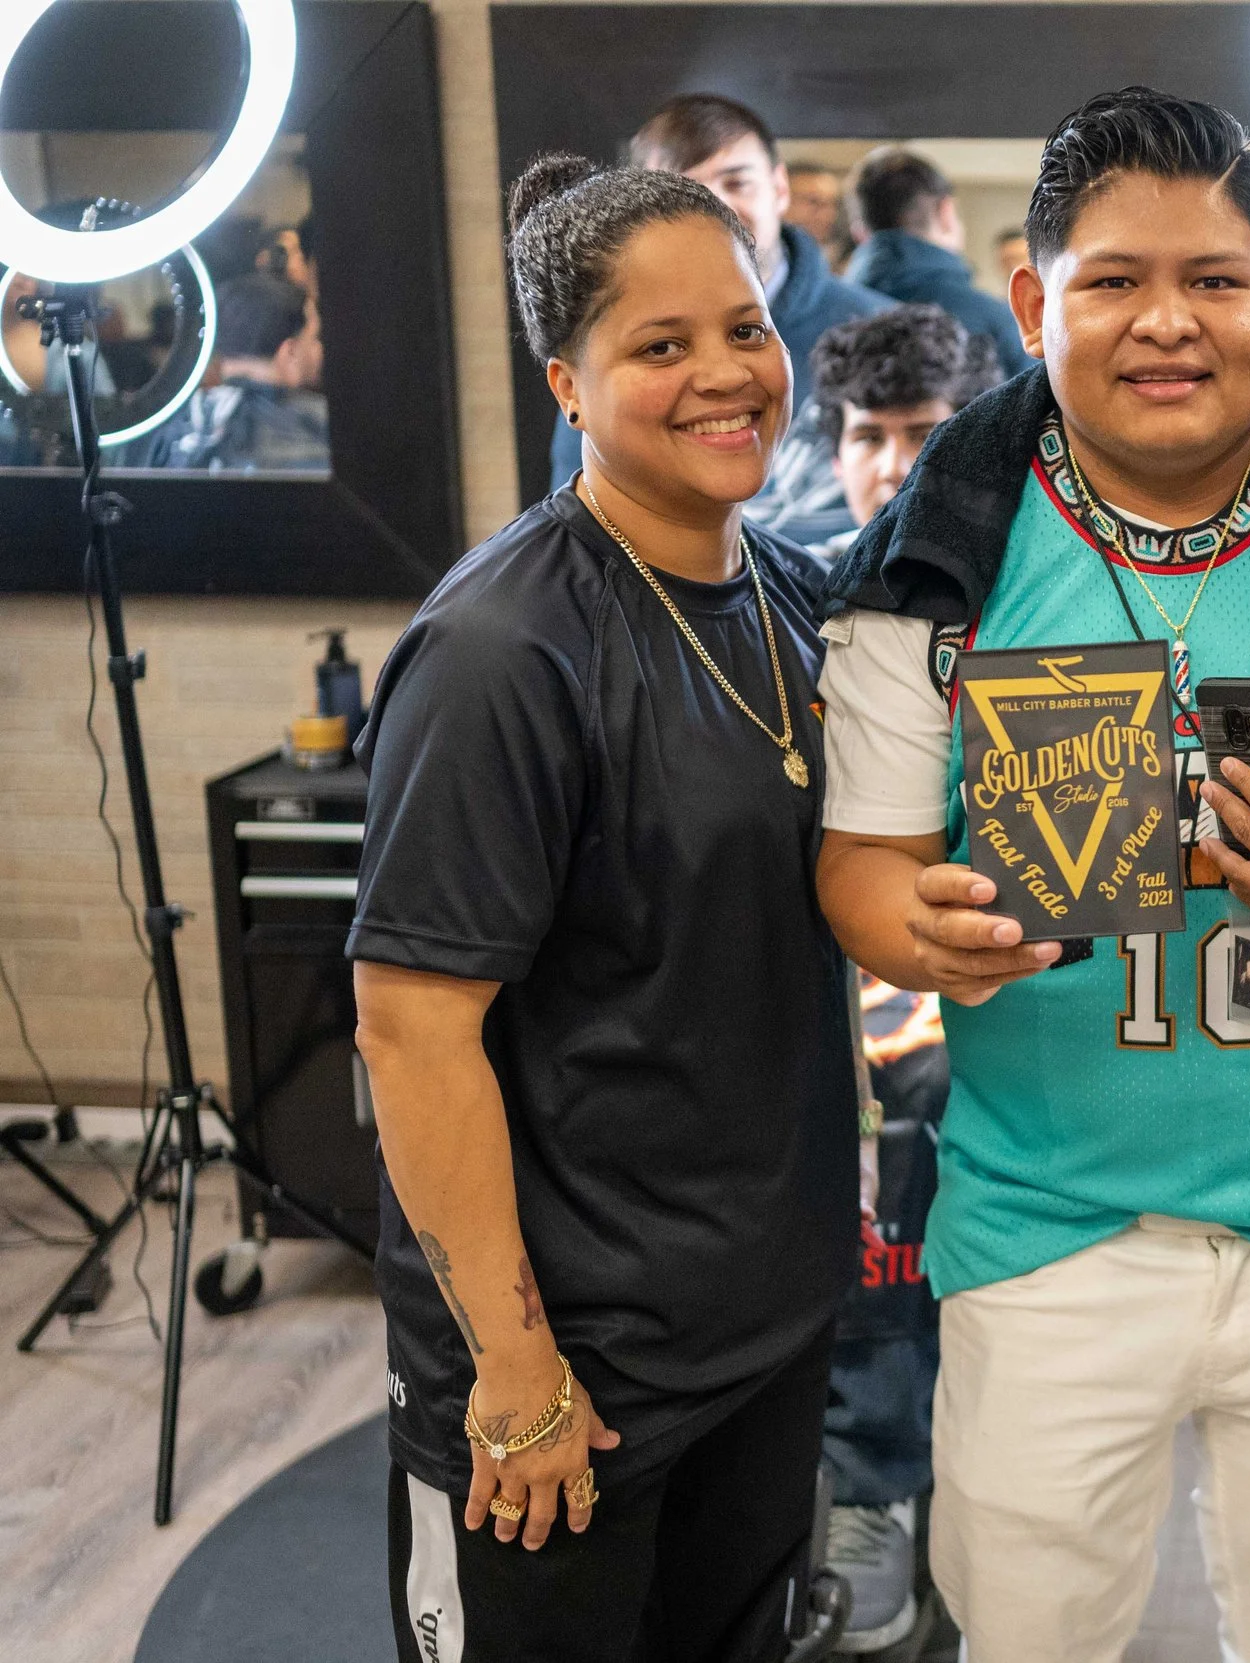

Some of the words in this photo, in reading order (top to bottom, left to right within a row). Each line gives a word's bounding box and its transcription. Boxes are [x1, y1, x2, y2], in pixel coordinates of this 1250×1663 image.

[997, 701, 1020, 712] MILL
[1023, 698, 1046, 711] CITY
[1049, 698, 1091, 710] BARBER
[1093, 695, 1132, 708] BATTLE
[1054, 783, 1099, 814] Studio
[1107, 797, 1129, 809] 2016
[1015, 802, 1033, 814] EST
[1122, 805, 1163, 858] Place
[977, 818, 1023, 867] Fast
[1018, 862, 1069, 920] Fade
[1136, 872, 1167, 889] Fall
[1139, 889, 1174, 908] 2021
